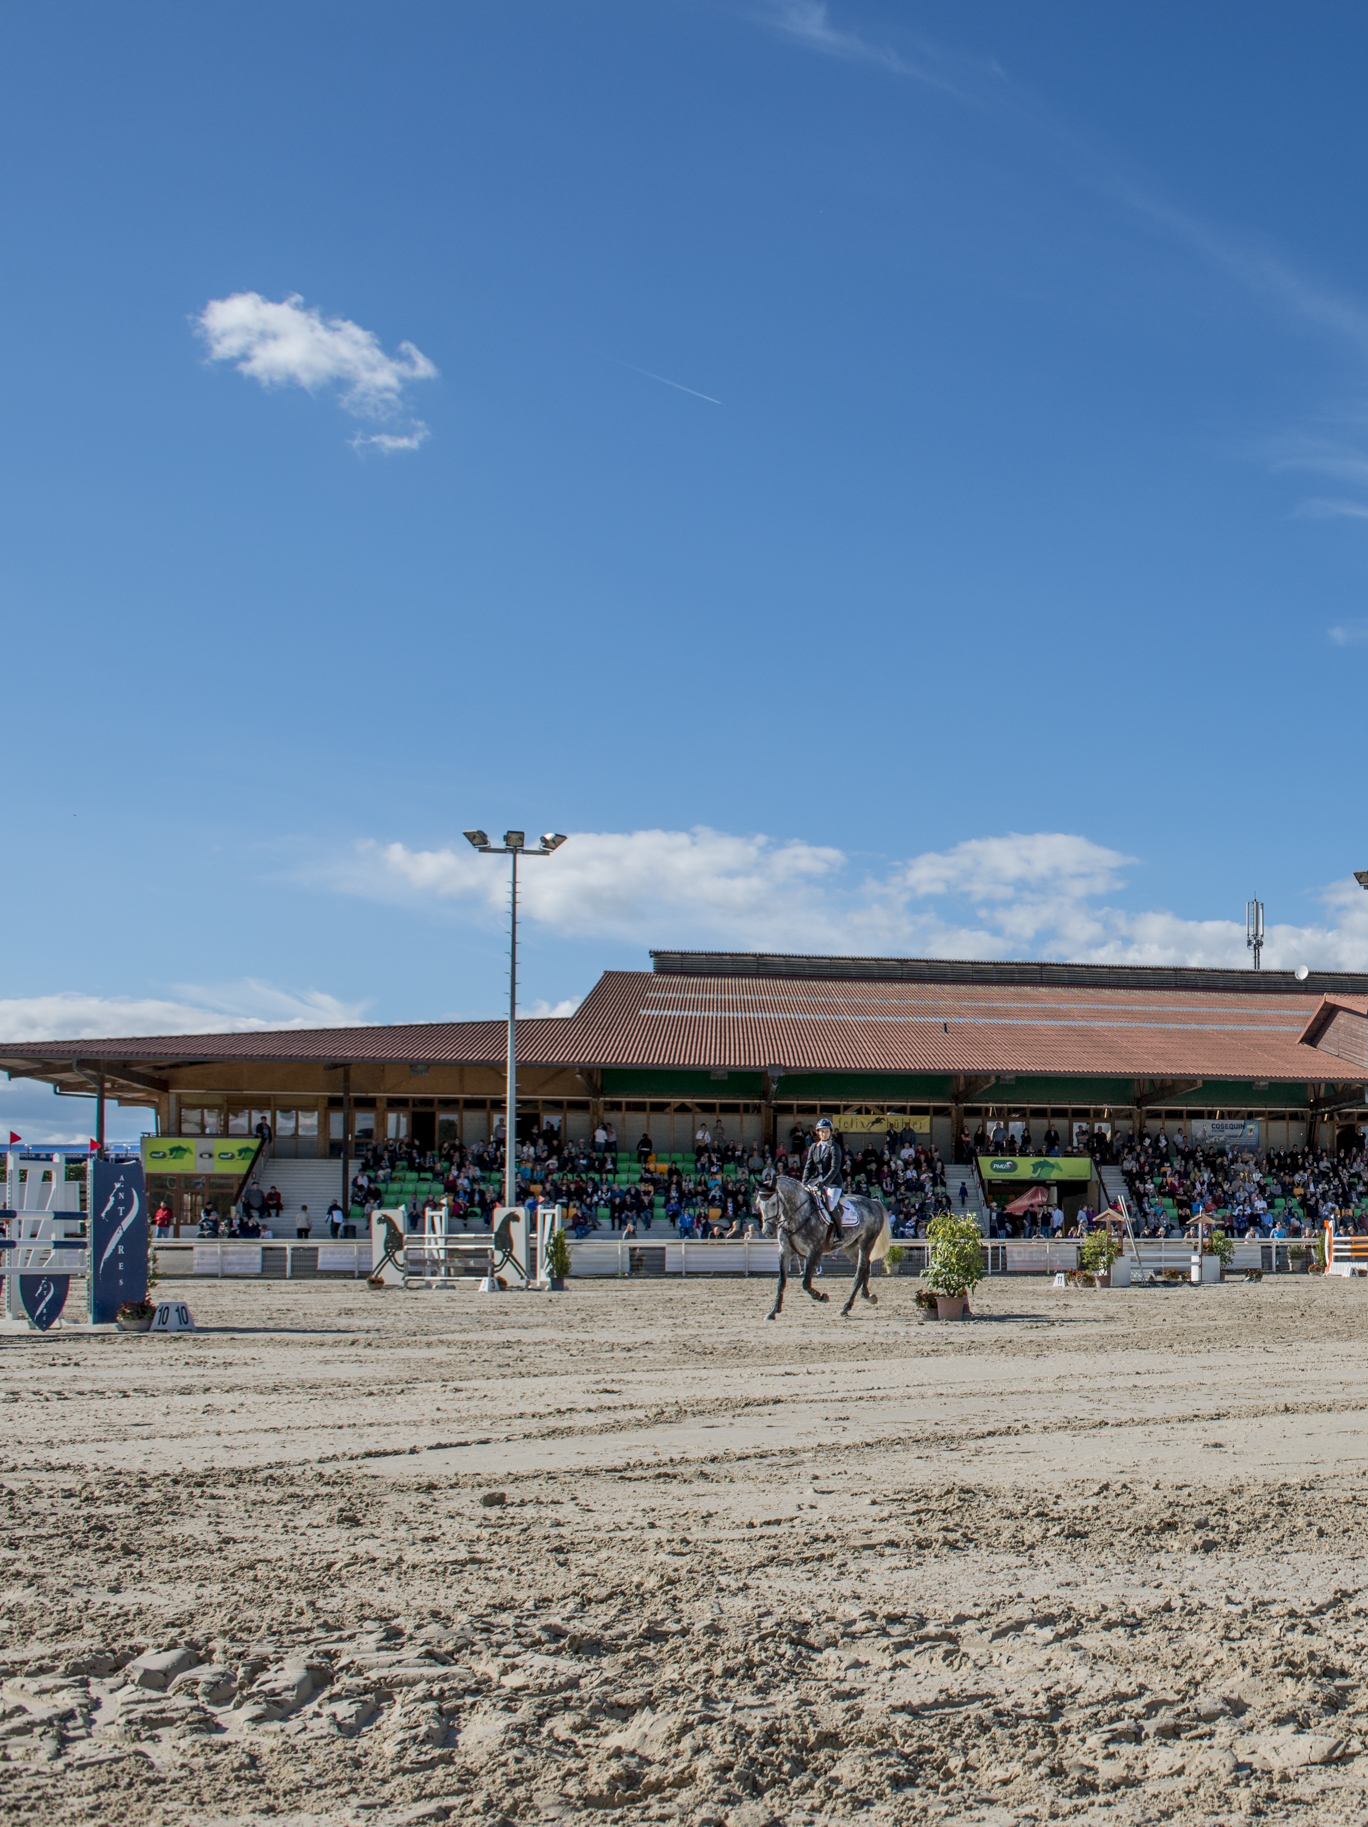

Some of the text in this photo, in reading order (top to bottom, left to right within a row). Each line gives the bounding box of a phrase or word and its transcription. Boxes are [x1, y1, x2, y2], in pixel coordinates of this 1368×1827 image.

[838, 1117, 866, 1129] felix
[158, 1305, 189, 1326] 10 10
